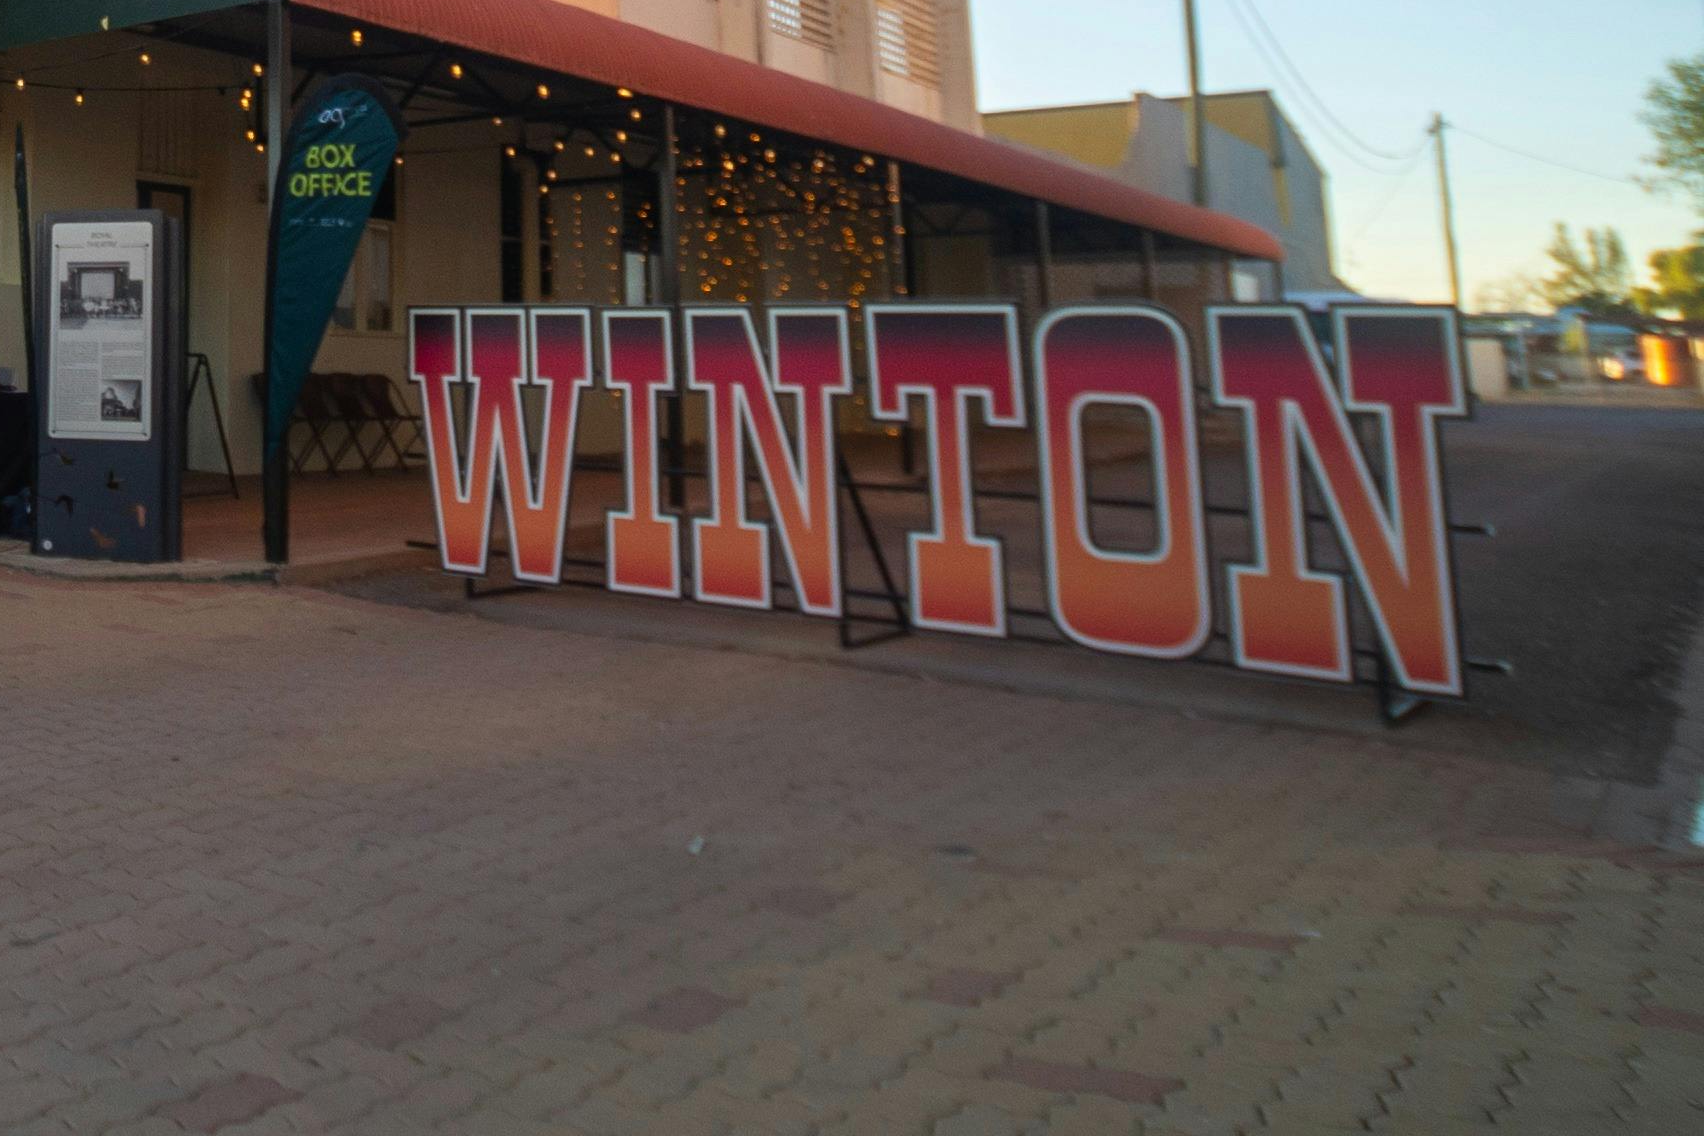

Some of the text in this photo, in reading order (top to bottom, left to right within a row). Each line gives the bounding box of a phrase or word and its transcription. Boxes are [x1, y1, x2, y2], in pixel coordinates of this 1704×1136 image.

[305, 144, 356, 169] BOX
[289, 171, 373, 197] OFFICE
[407, 302, 1468, 696] WINTON
